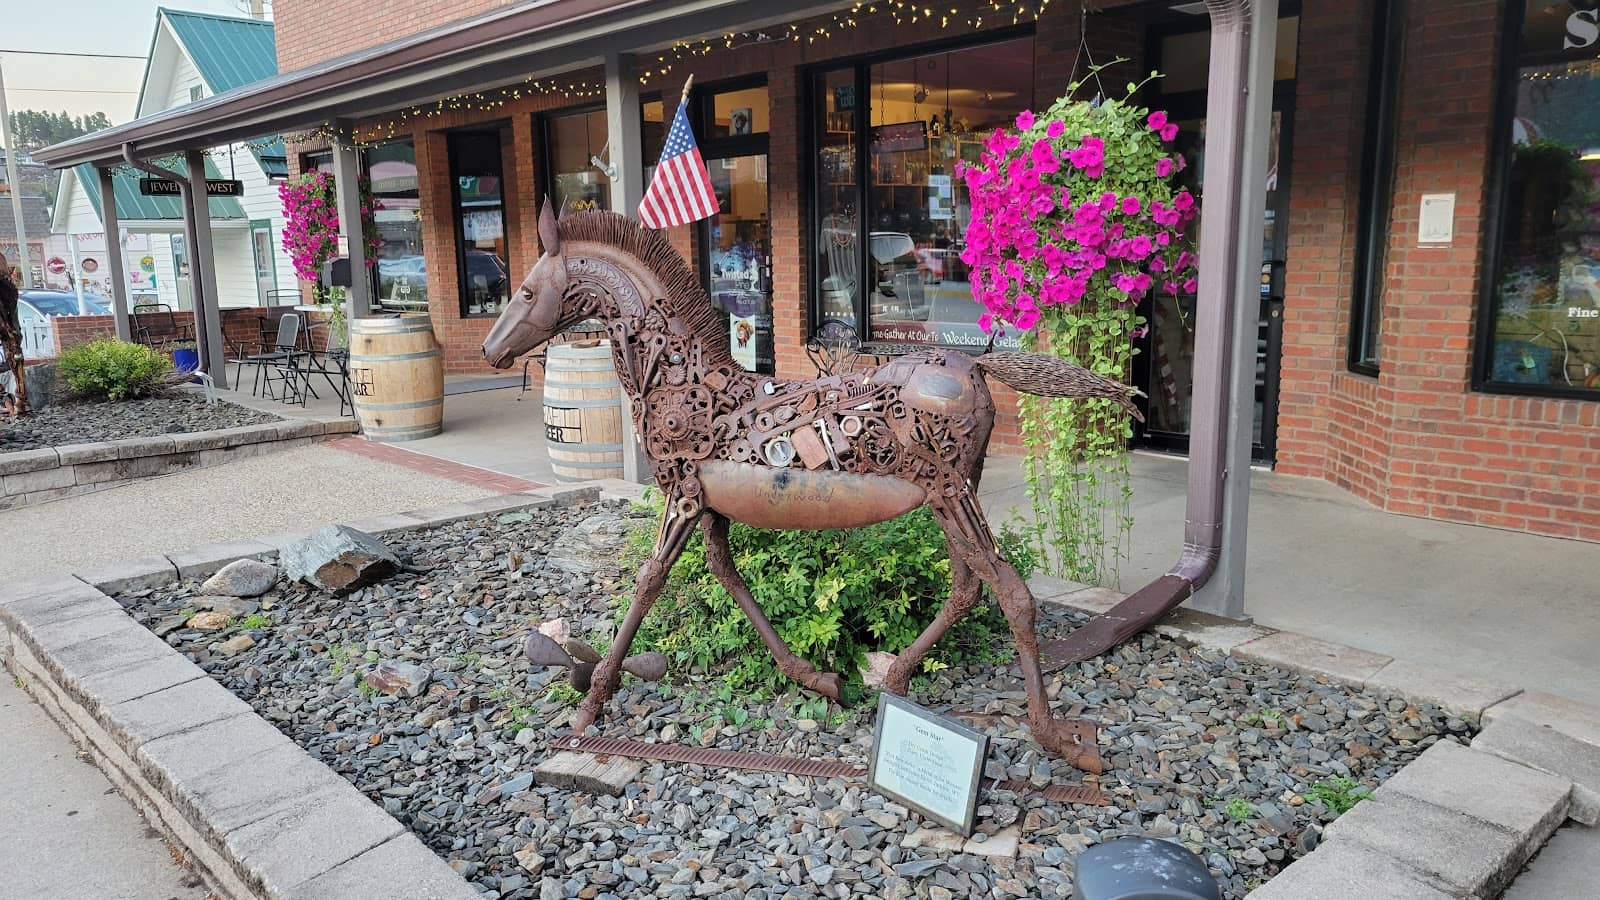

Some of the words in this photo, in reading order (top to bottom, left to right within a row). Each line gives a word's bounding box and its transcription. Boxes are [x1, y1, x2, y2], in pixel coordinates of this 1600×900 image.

[1563, 8, 1599, 50] S
[206, 183, 235, 193] WEST
[1568, 307, 1599, 318] Fine
[884, 329, 907, 339] Gather
[907, 330, 916, 340] At
[917, 330, 930, 341] Our
[942, 331, 989, 346] Weekend
[993, 334, 1019, 348] Gela
